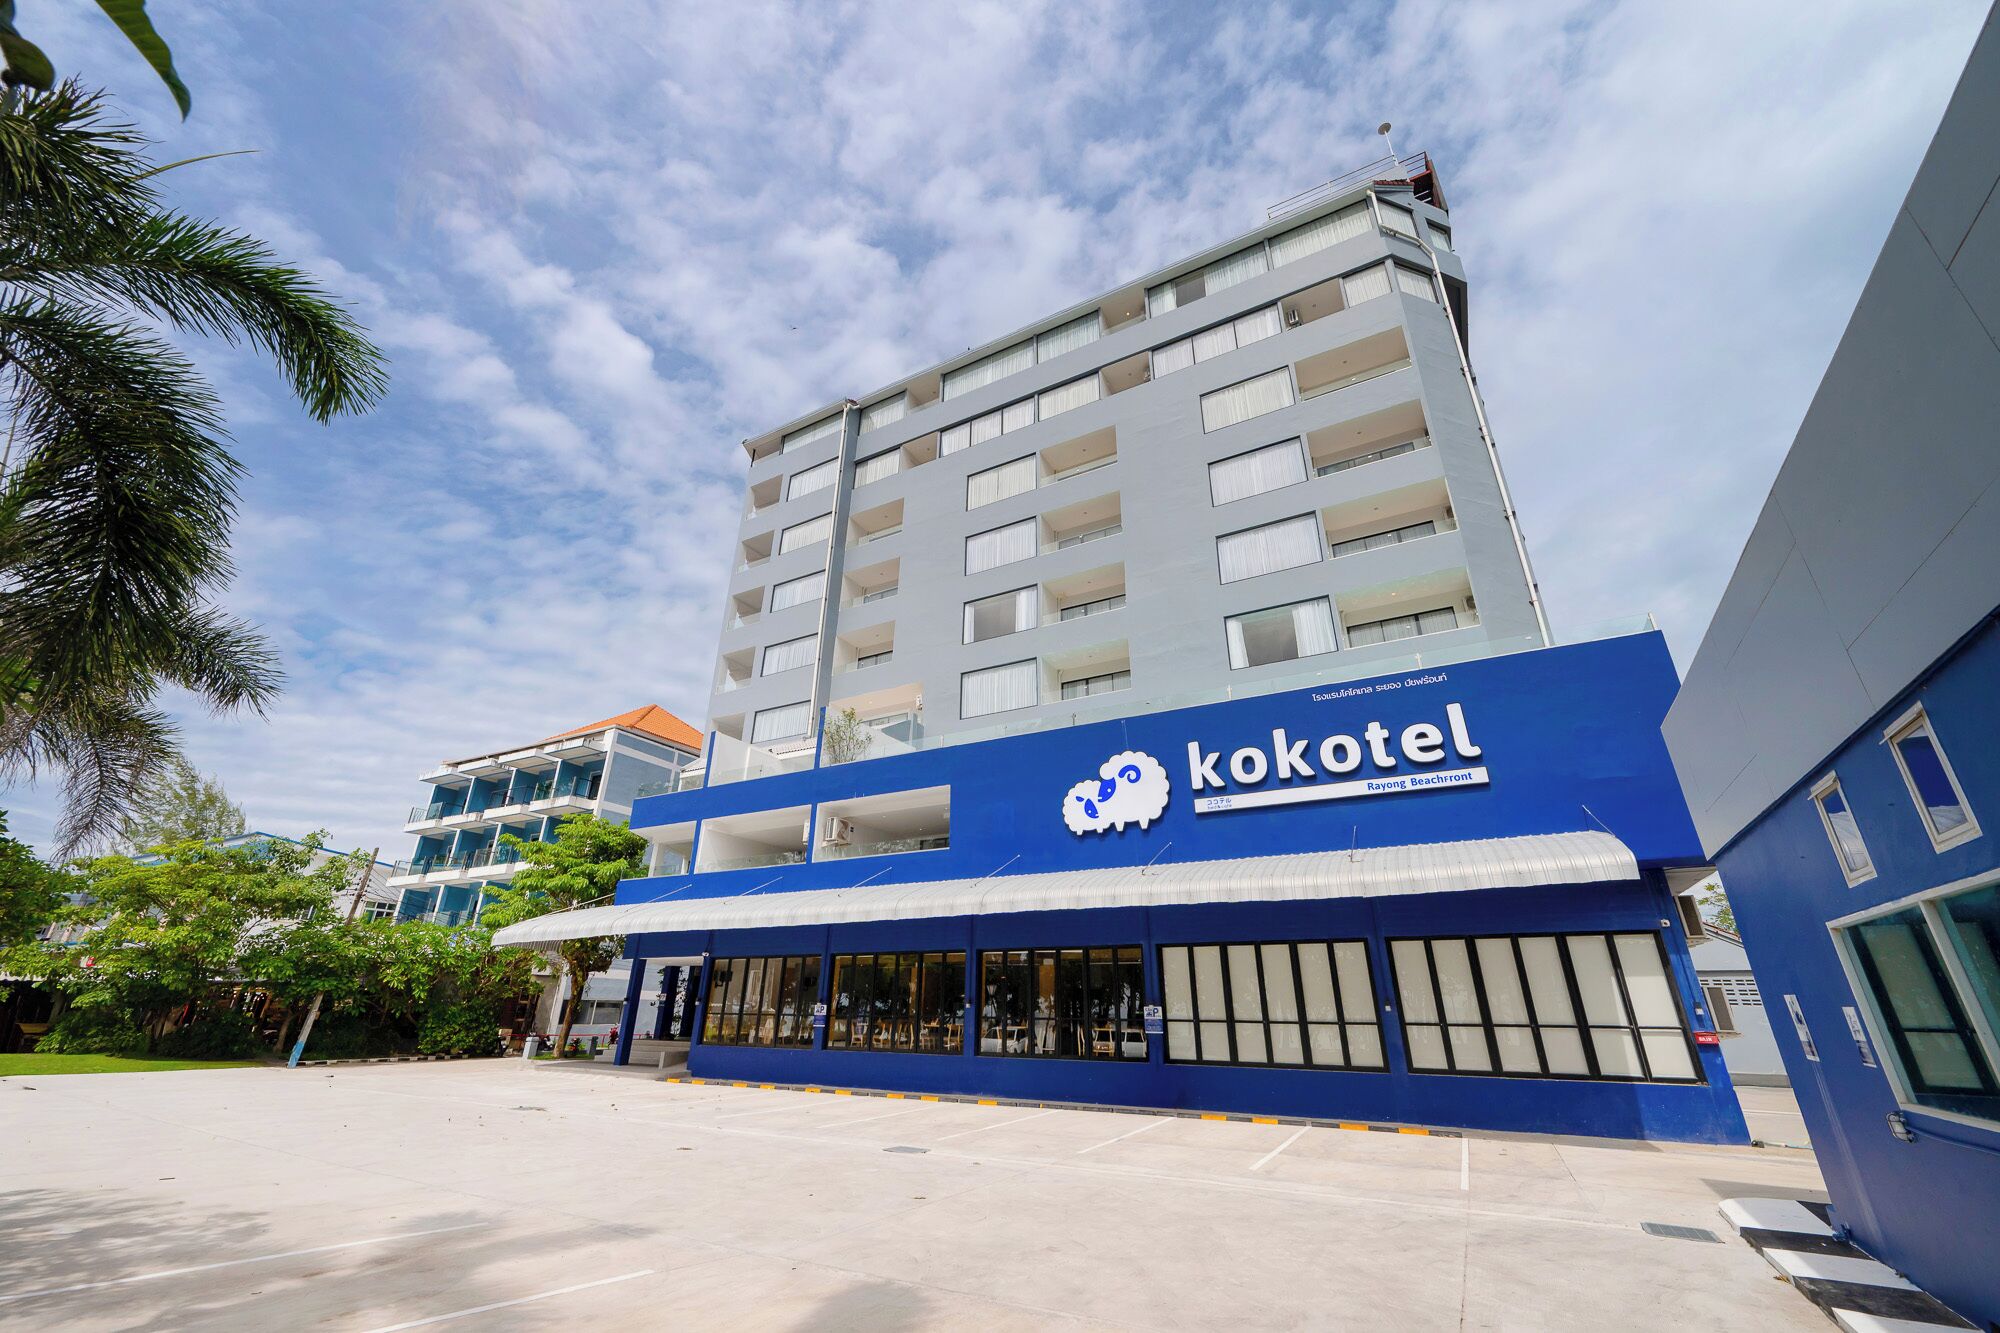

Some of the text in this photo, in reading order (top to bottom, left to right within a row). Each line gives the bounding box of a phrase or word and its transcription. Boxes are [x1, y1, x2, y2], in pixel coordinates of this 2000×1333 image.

[1375, 682, 1402, 692] ระยอง
[1187, 702, 1482, 790] kokotel
[1367, 779, 1406, 792] Rayong
